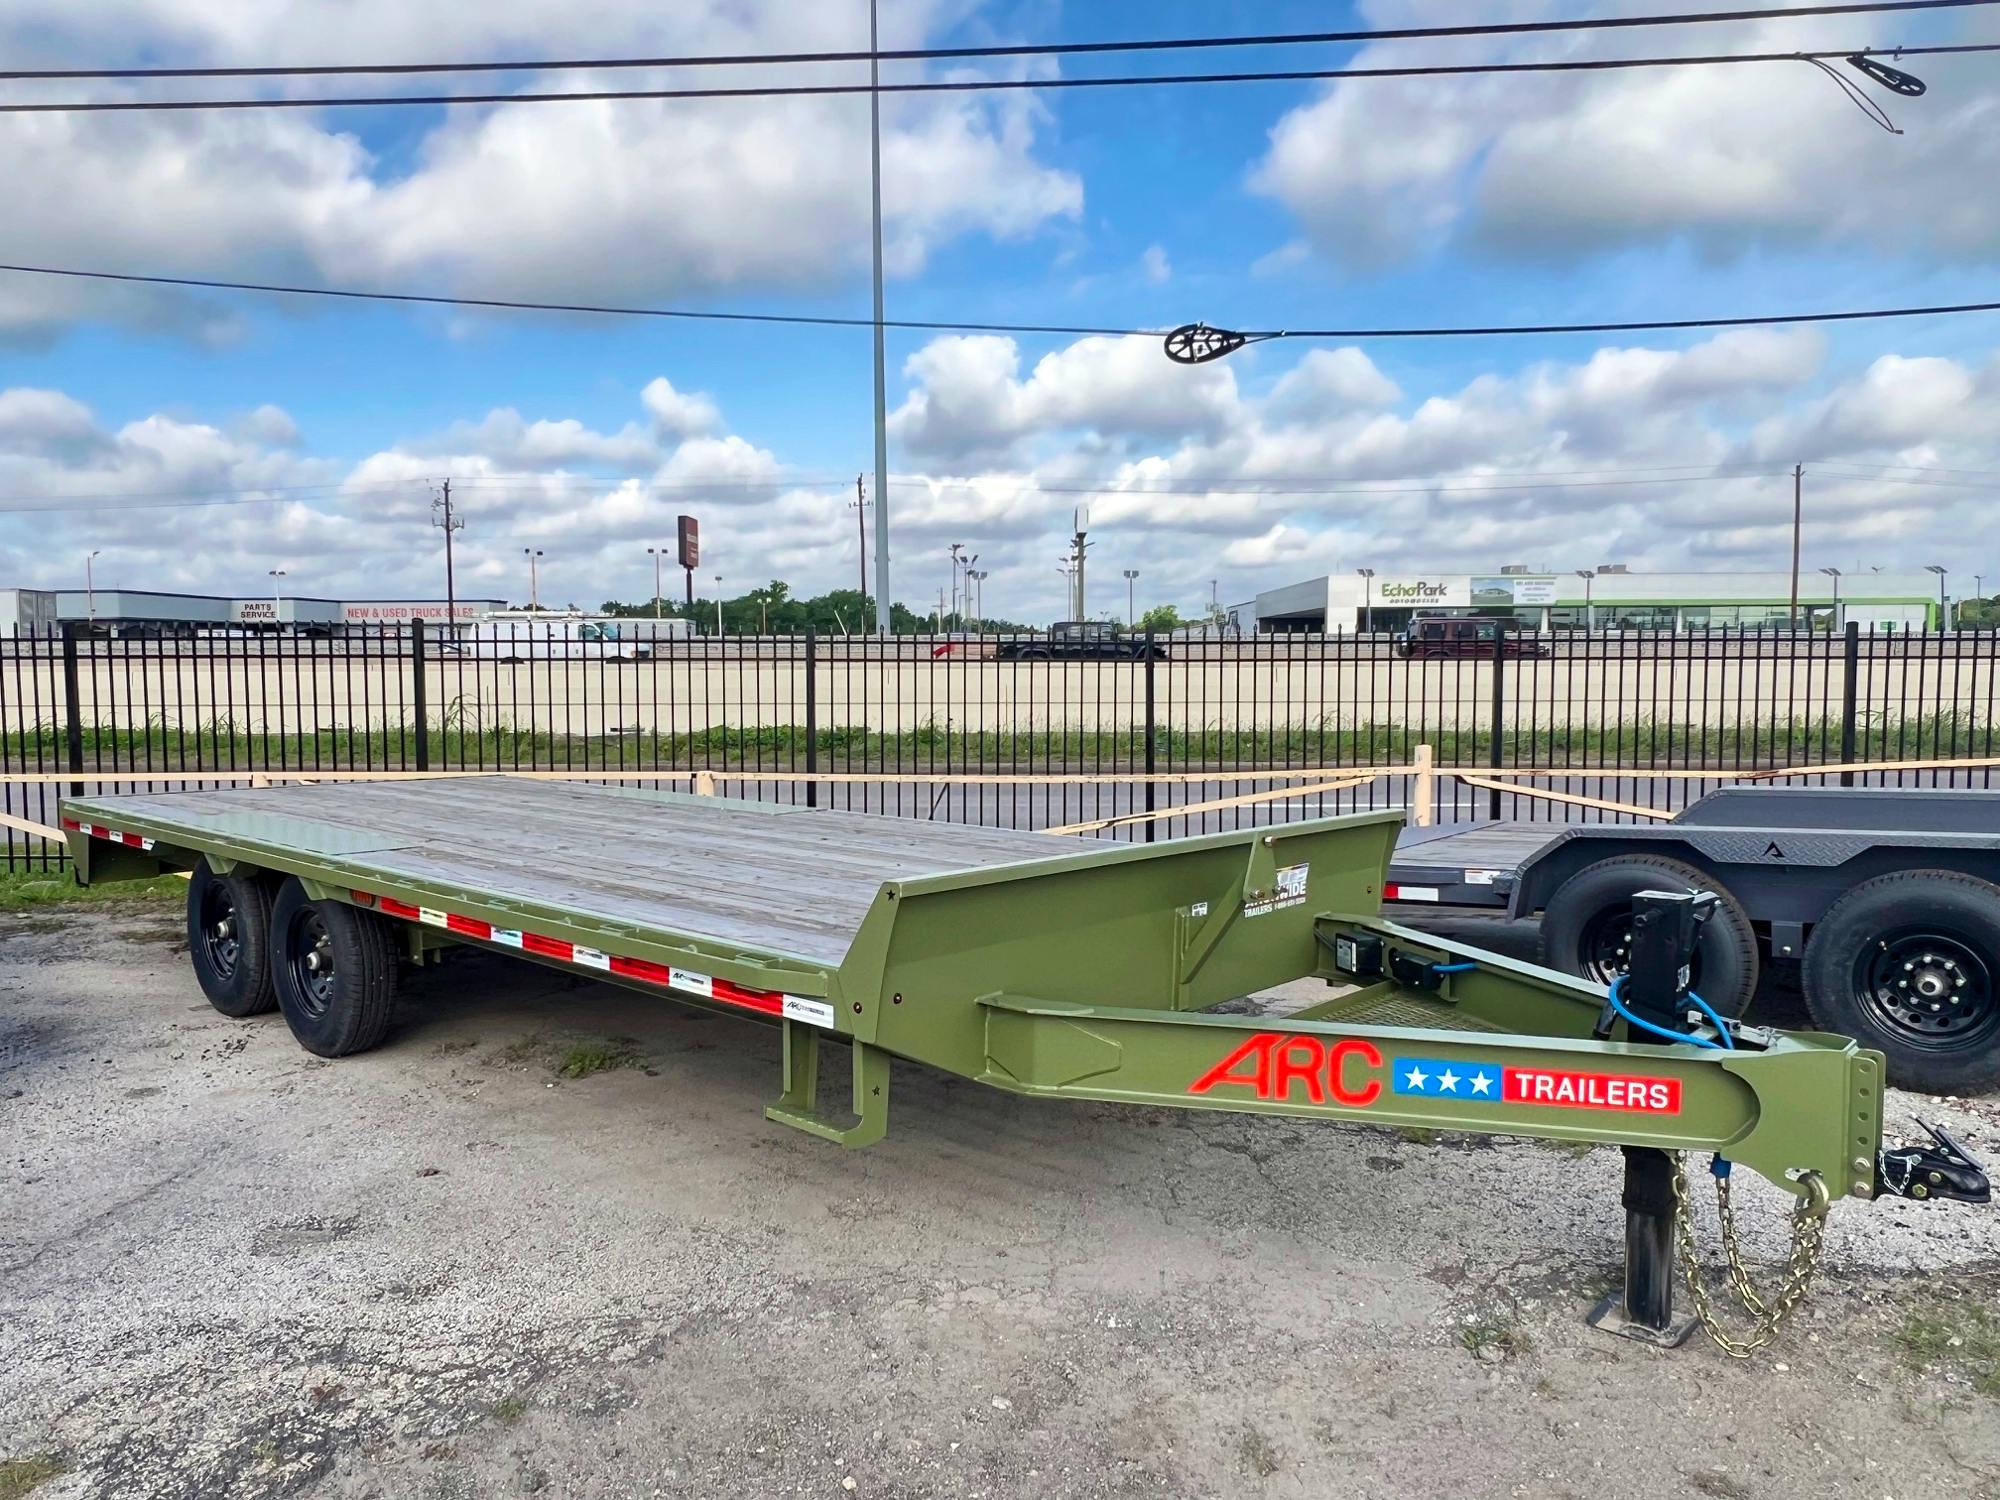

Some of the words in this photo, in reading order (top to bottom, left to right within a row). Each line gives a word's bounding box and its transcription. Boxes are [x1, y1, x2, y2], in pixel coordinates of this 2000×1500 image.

[1382, 581, 1447, 597] EchoPark
[240, 611, 277, 619] SERVICE
[347, 608, 370, 618] NEW
[372, 608, 379, 618] &
[382, 608, 407, 618] USED
[411, 608, 442, 617] TRUCK
[445, 608, 474, 618] SALES
[1244, 904, 1273, 918] TRAILERS
[1186, 1033, 1384, 1107] ARC
[1515, 1073, 1669, 1109] TRAILERS
